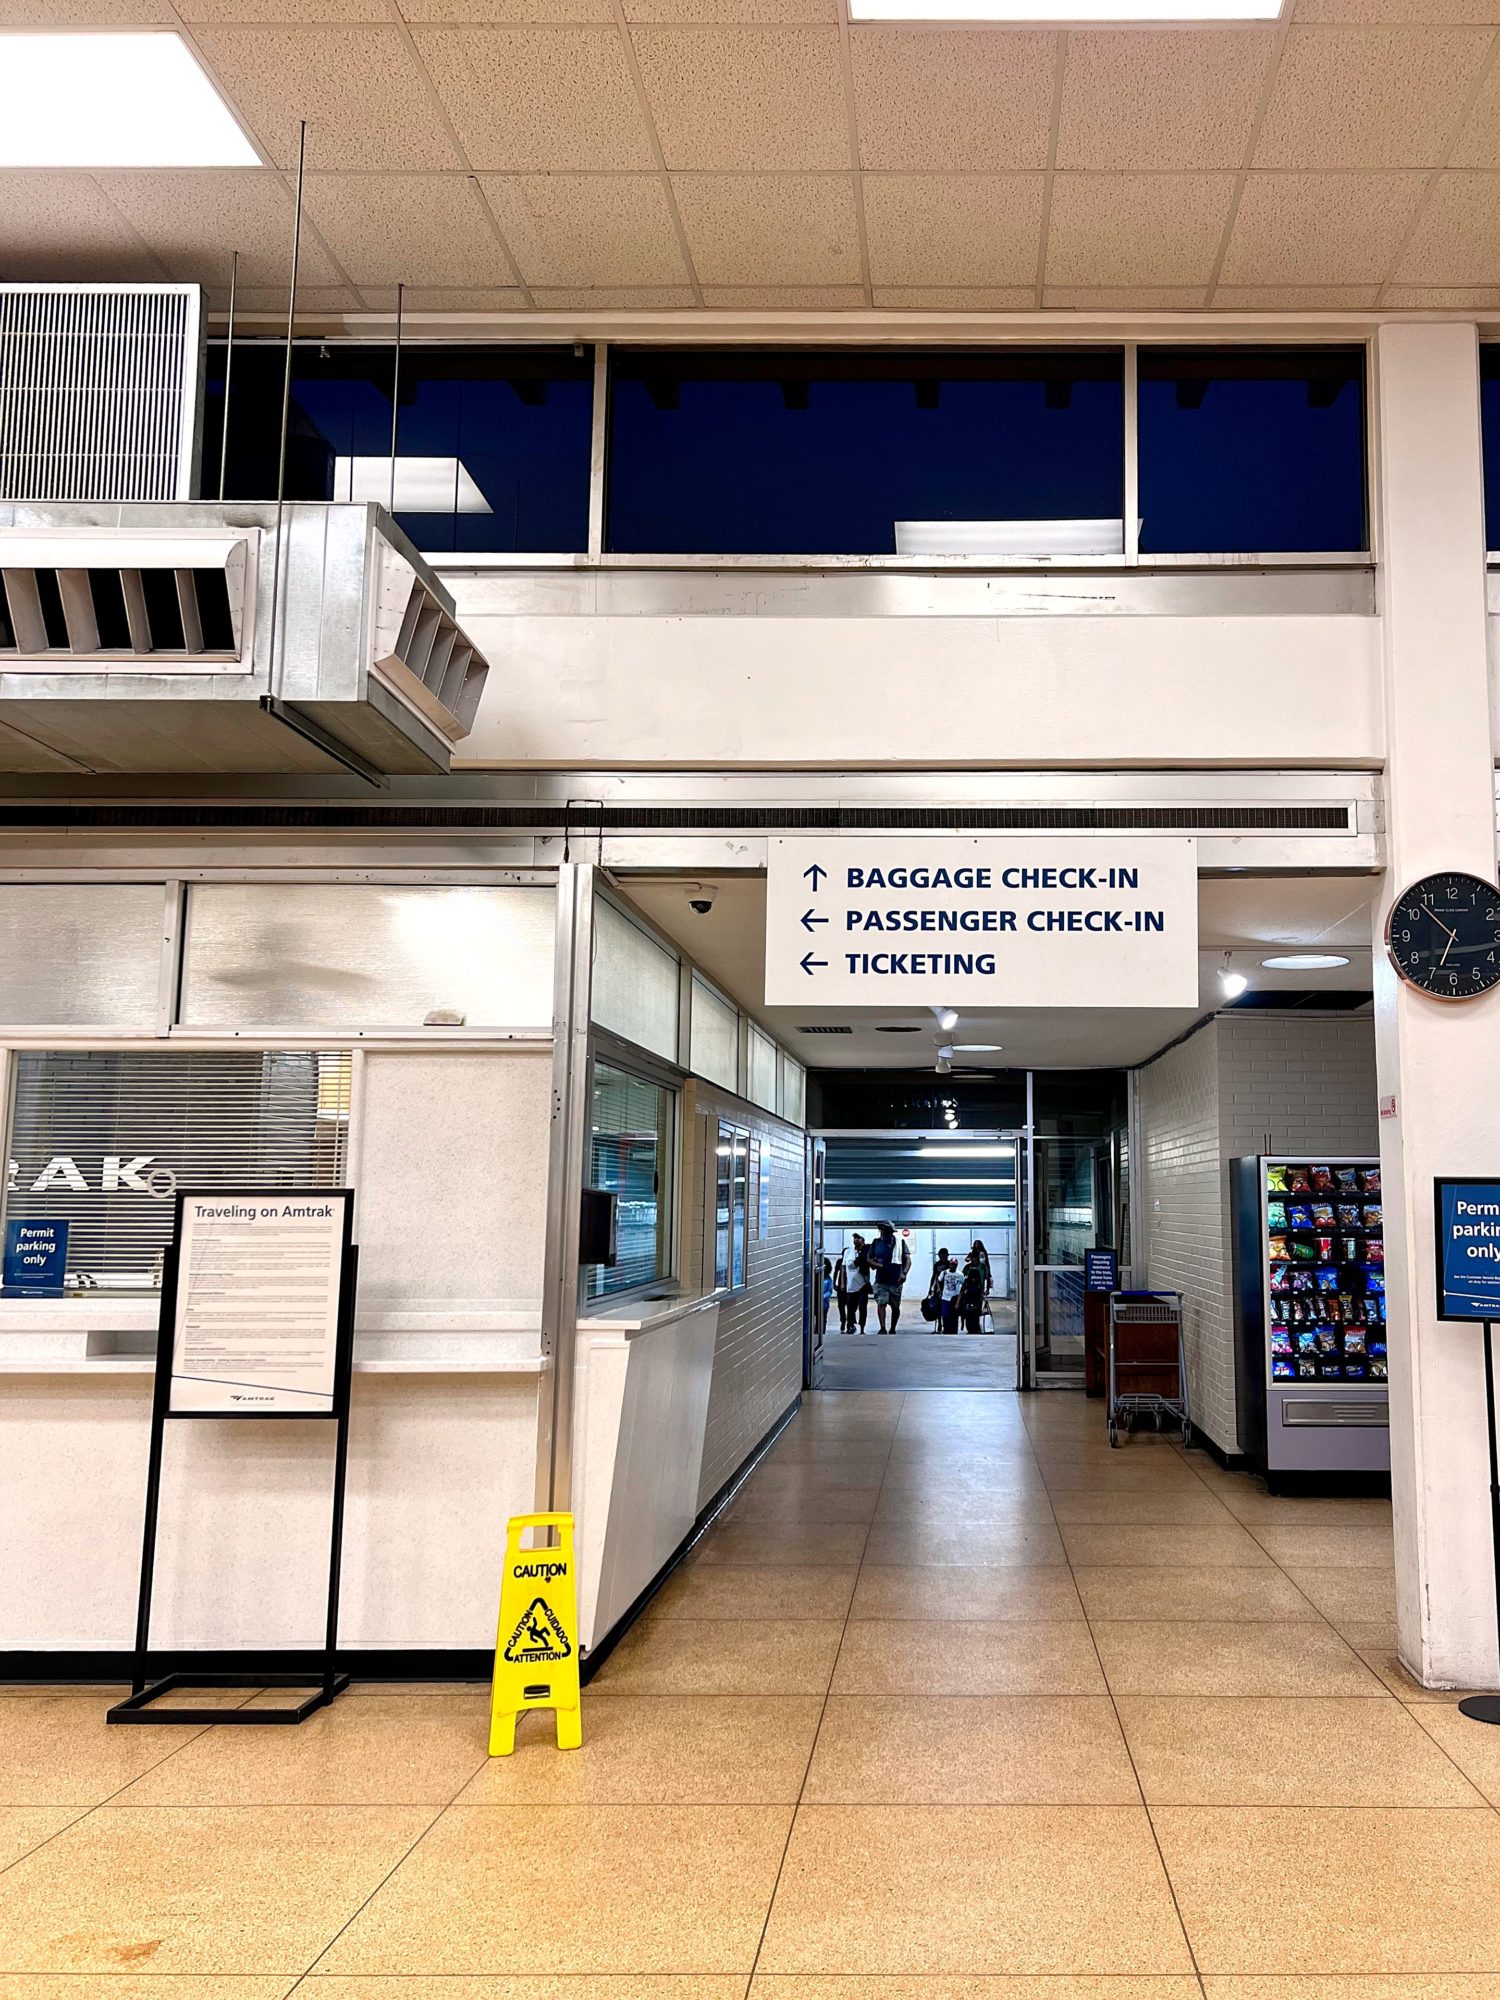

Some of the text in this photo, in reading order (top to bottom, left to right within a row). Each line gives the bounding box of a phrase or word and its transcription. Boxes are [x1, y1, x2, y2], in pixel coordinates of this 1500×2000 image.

[847, 867, 1139, 889] BAGGAGE CHECK-IN
[1421, 893, 1435, 906] 11
[1445, 887, 1458, 900] 12
[1470, 893, 1477, 906] 1
[846, 909, 1165, 932] PASSENGER CHECK-IN
[1406, 908, 1420, 921] 10
[1485, 908, 1495, 921] 2
[1401, 930, 1411, 943] 9
[1410, 951, 1420, 964] 8
[1486, 951, 1496, 964] 4
[845, 953, 996, 976] TICKETING
[1428, 966, 1437, 980] 7
[1449, 972, 1458, 986] 6
[1472, 967, 1481, 980] 5
[194, 1205, 333, 1221] Traveling on Amtrak
[20, 1228, 55, 1238] Permit
[16, 1241, 56, 1253] parking
[23, 1254, 47, 1266] only
[513, 1563, 567, 1579] CAUTION
[508, 1609, 534, 1648] CAUTION
[544, 1608, 569, 1645] CUIDADO
[513, 1651, 561, 1664] ATTENTION
